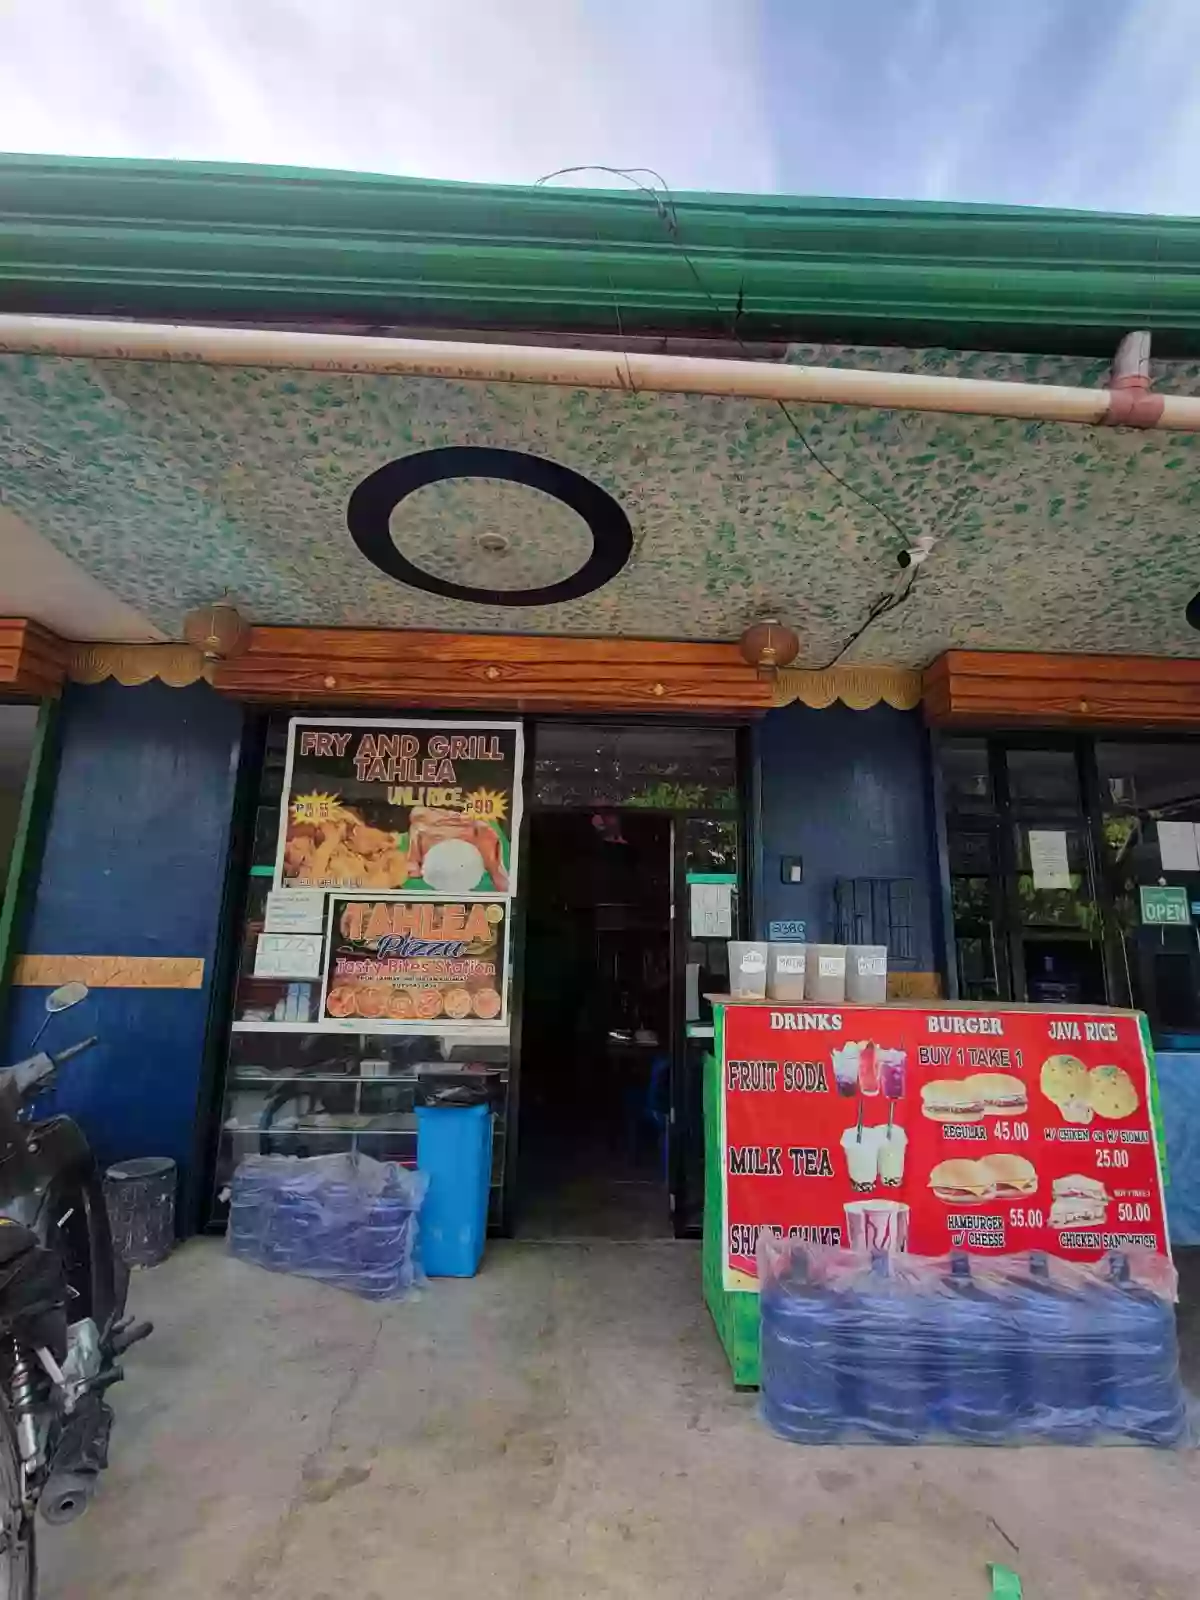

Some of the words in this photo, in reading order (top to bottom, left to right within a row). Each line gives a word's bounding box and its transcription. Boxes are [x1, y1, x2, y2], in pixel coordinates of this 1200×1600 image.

[300, 732, 351, 756] FRY
[356, 733, 419, 759] AND
[427, 736, 504, 760] GRILL
[353, 757, 456, 783] TAHLEA
[345, 902, 492, 941] TAHLEA
[1146, 903, 1185, 920] OPEN
[377, 931, 467, 960] Pizza
[335, 957, 383, 975] Tasty
[387, 958, 429, 973] Bites
[435, 958, 496, 976] Station
[770, 1012, 843, 1030] DRINKS
[928, 1016, 1003, 1035] BURGER
[1048, 1021, 1082, 1040] JAVA
[1084, 1022, 1118, 1041] RICE
[919, 1047, 952, 1065] BUY
[956, 1048, 965, 1066] 1
[967, 1048, 1011, 1067] TAKE
[1015, 1050, 1023, 1068] 1
[728, 1061, 778, 1092] FRUIT
[783, 1063, 828, 1093] SODA
[943, 1125, 988, 1140] REGULAR
[993, 1121, 1029, 1141] 45.00
[729, 1146, 783, 1175] MILK
[788, 1148, 834, 1176] TEA
[1095, 1149, 1129, 1168] 25.00
[1009, 1208, 1043, 1228] 55.00
[1118, 1203, 1151, 1221] 50.00
[948, 1215, 1003, 1230] HAMBURGER
[967, 1232, 1005, 1248] CHEESE
[1059, 1231, 1100, 1249] CHICKEN
